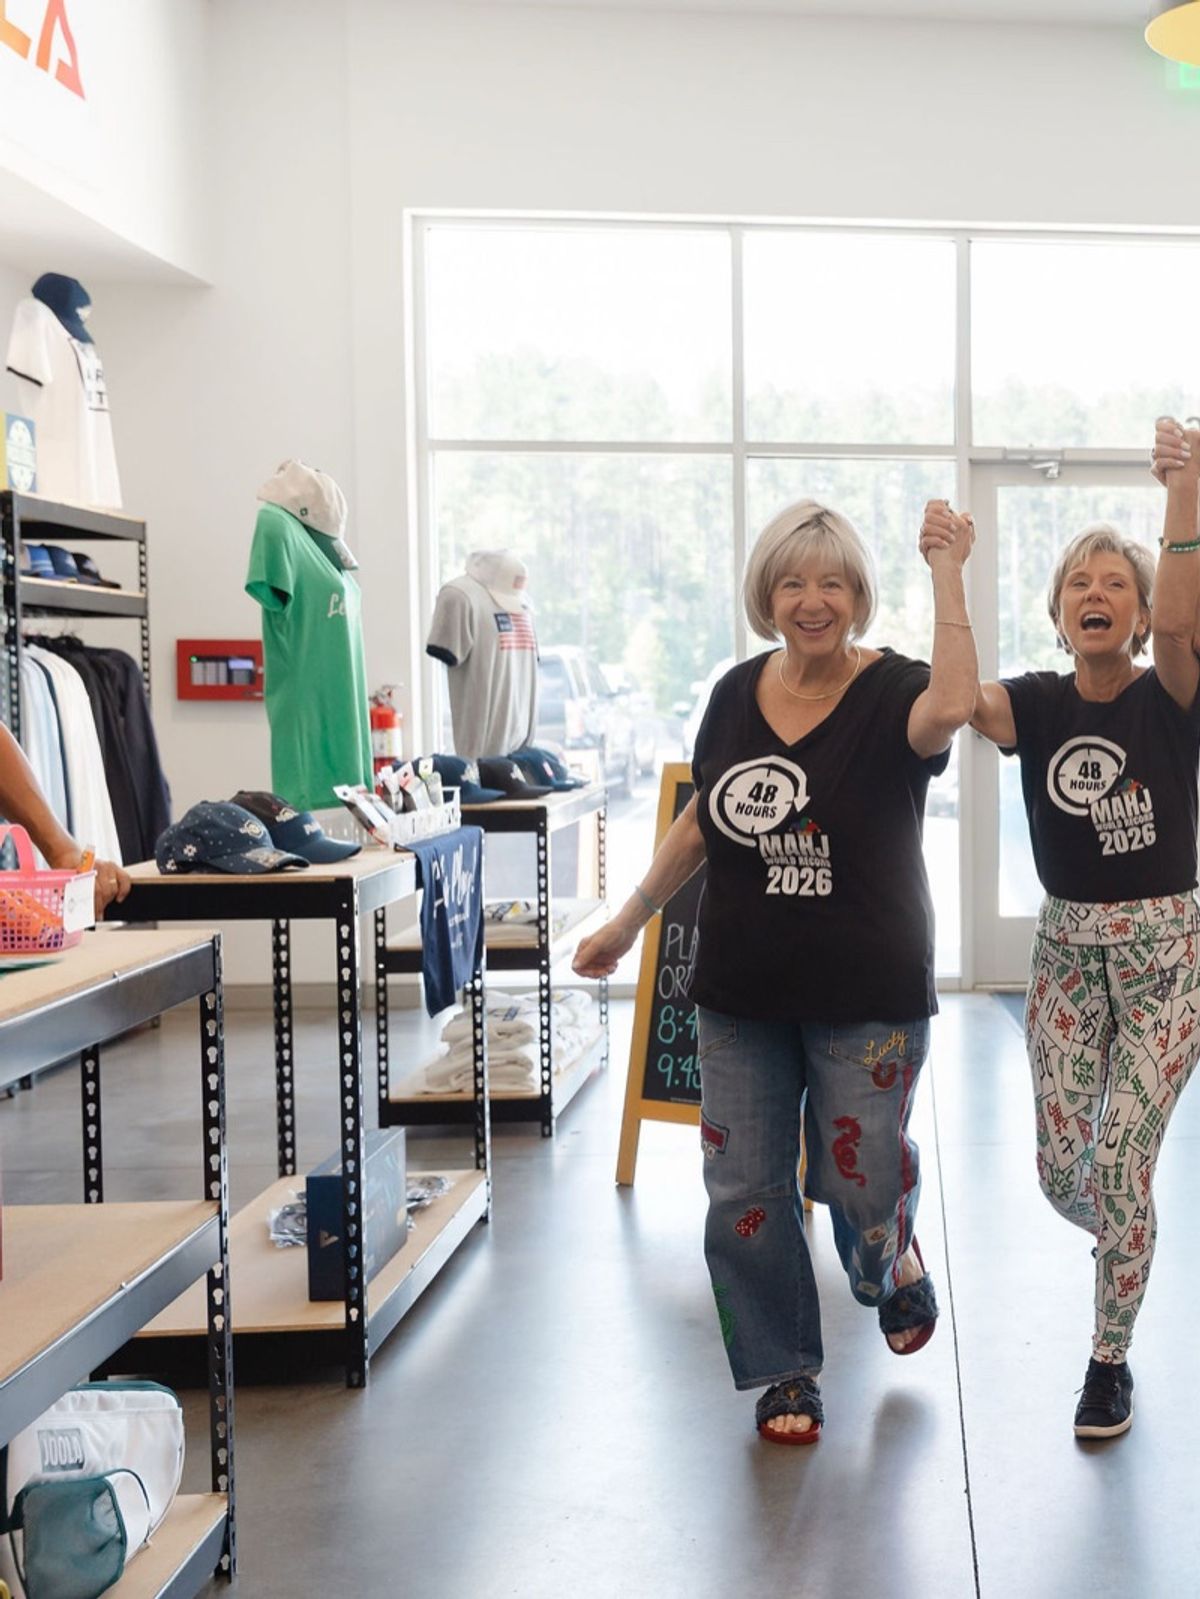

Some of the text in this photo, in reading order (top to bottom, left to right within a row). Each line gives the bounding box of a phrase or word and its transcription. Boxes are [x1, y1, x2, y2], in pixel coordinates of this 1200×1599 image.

[1078, 761, 1102, 780] 48
[748, 781, 778, 804] 48
[1069, 779, 1107, 792] HOURS
[735, 801, 778, 819] HOURS
[1090, 788, 1153, 825] MAHJ
[758, 833, 830, 859] MAHJ
[1099, 822, 1157, 856] 2026
[766, 865, 833, 896] 2026
[863, 1030, 909, 1065] Lucky
